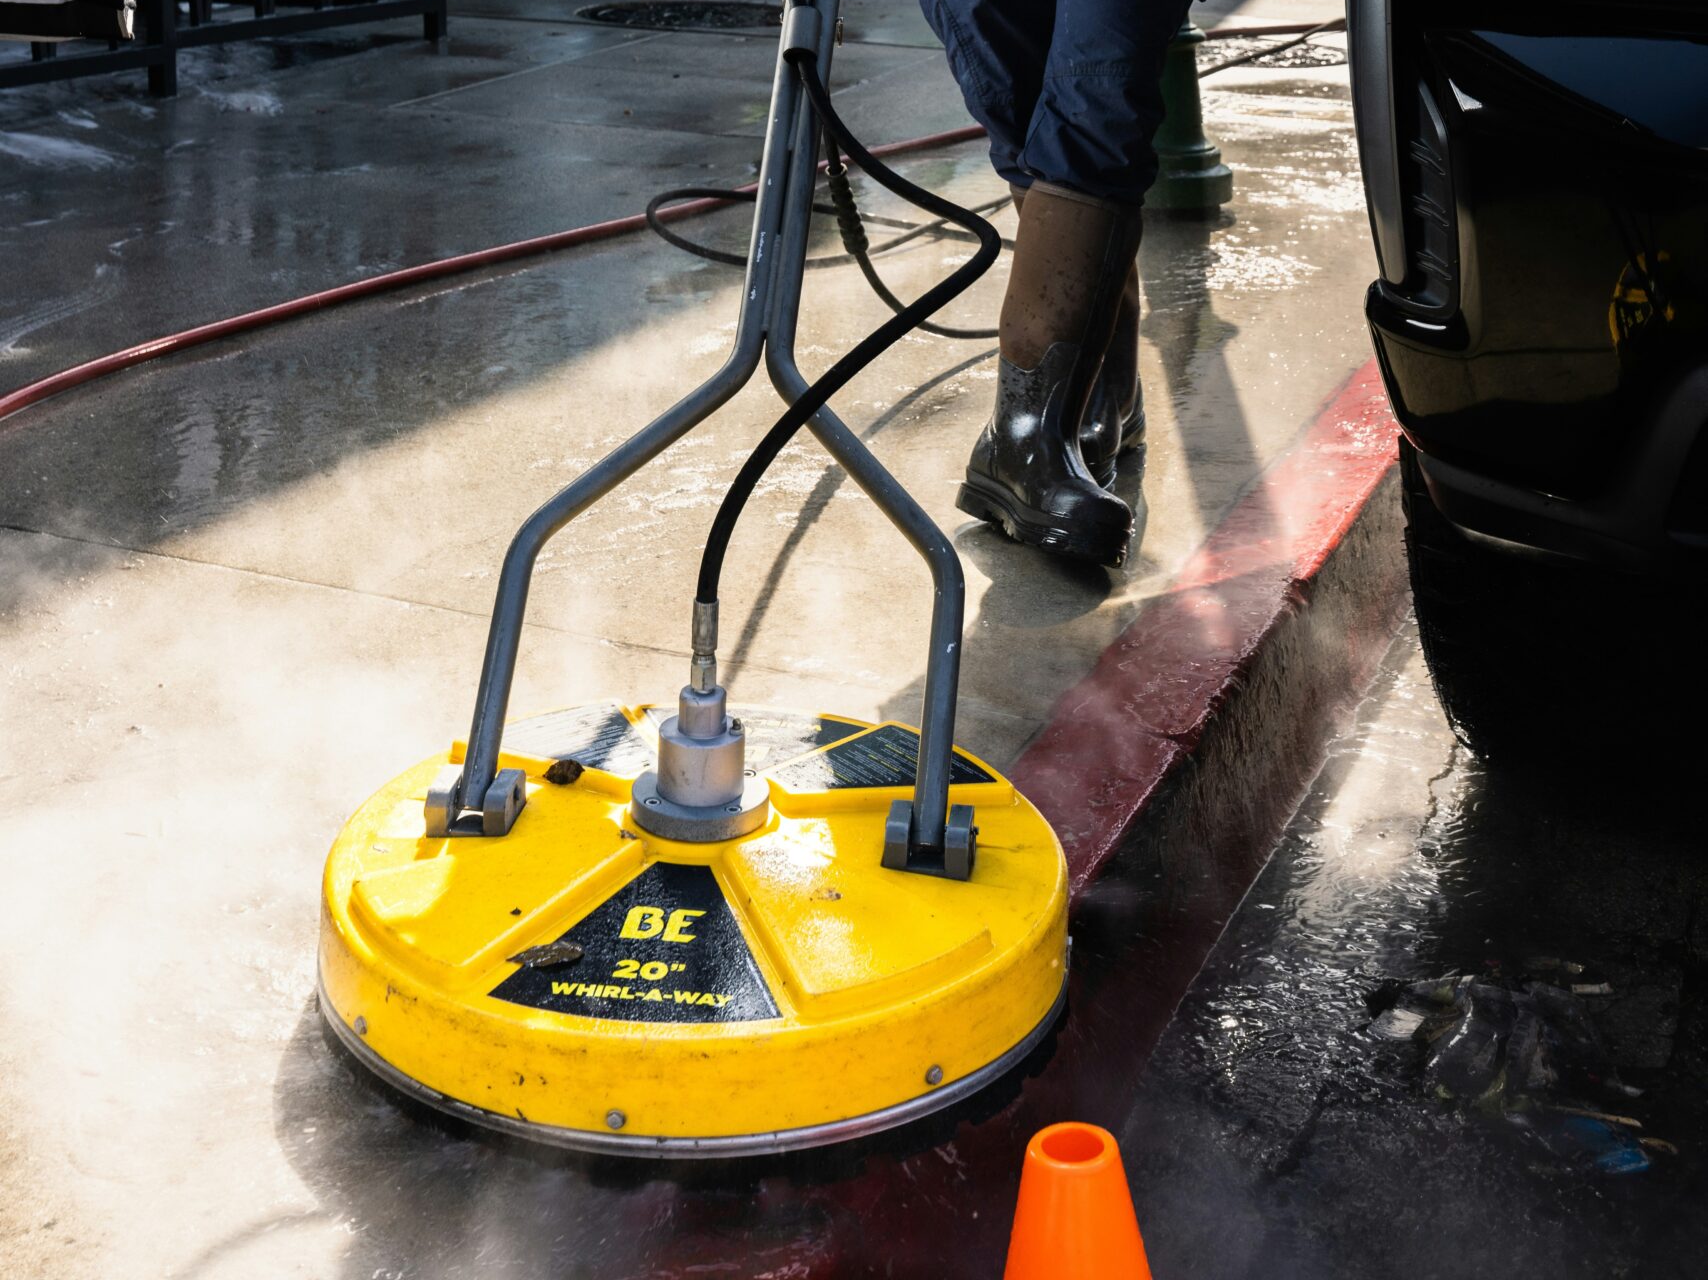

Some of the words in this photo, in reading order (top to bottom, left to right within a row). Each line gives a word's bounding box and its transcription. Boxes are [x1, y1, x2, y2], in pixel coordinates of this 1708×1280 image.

[618, 905, 707, 943] BE
[612, 959, 686, 981] 20"
[551, 981, 734, 1008] WHIRL-A-WAY
